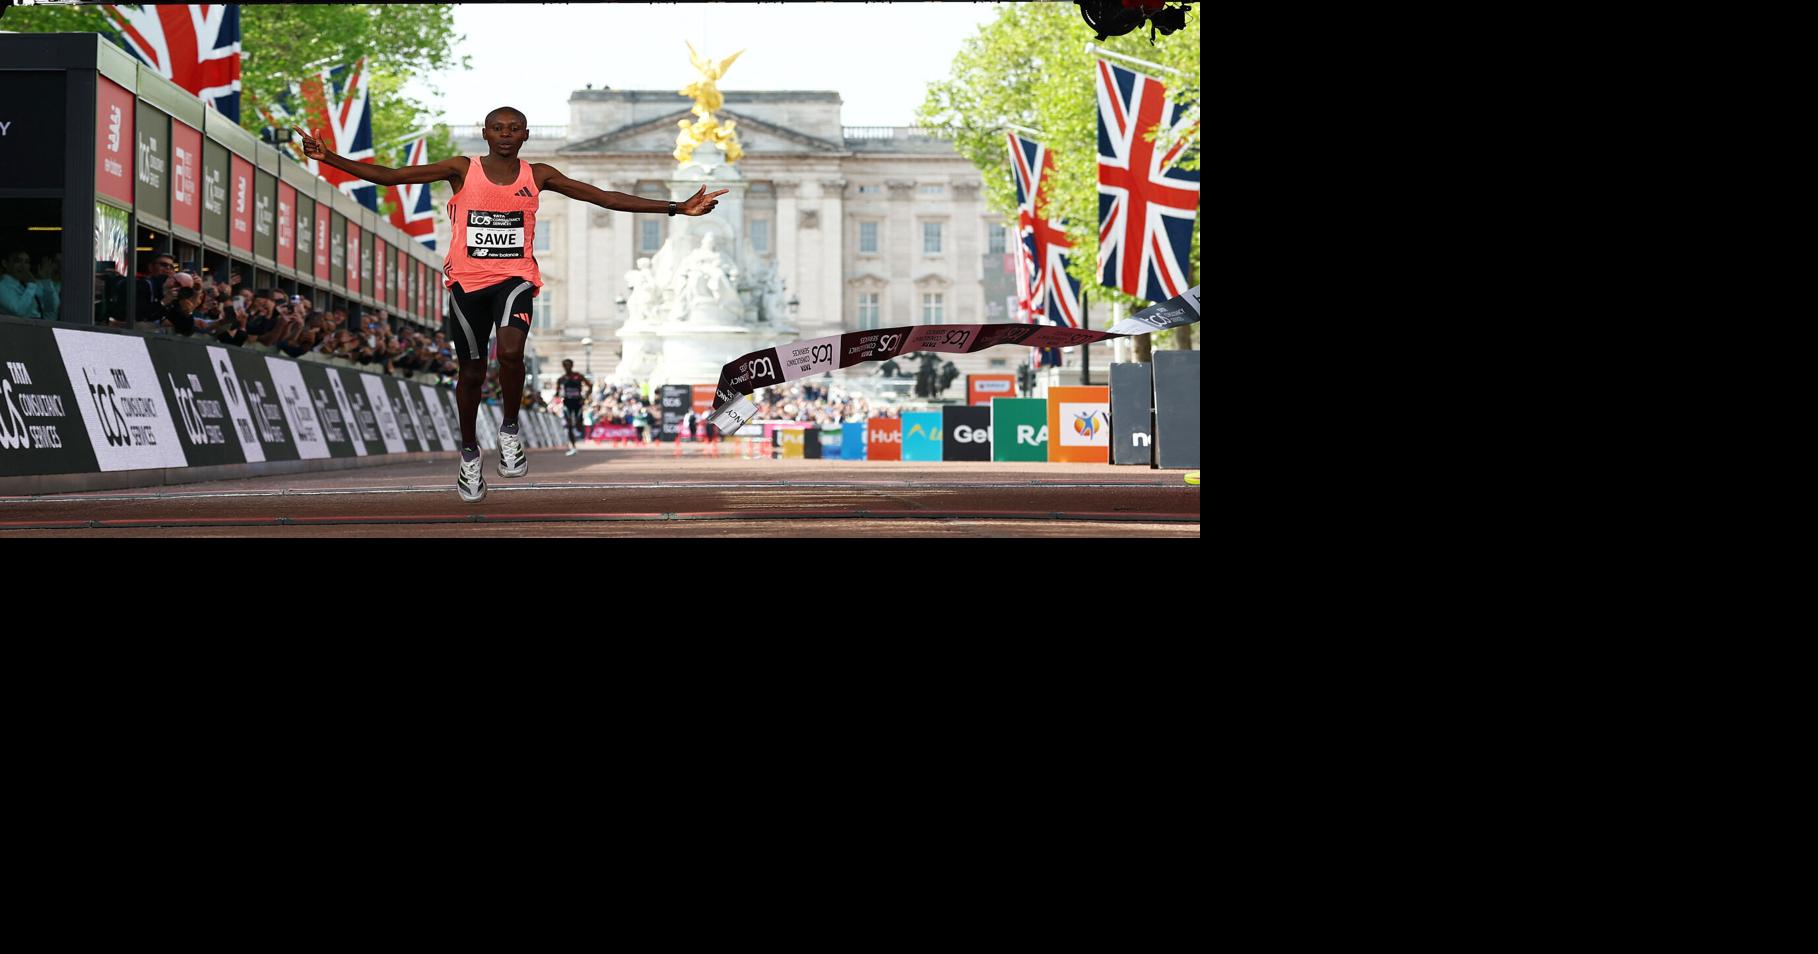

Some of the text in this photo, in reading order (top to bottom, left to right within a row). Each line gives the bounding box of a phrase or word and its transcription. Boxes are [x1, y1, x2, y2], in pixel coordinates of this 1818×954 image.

[471, 213, 491, 225] tcs
[475, 233, 516, 245] SAWE
[878, 334, 902, 353] tcs
[942, 330, 970, 349] tcs
[786, 355, 810, 368] CONSULTANCY
[792, 347, 810, 356] SERVICES
[811, 343, 833, 365] tcs
[6, 361, 32, 385] TATA
[110, 368, 131, 389] TATA
[748, 356, 775, 380] tcs
[800, 364, 811, 372] TATA
[18, 393, 66, 417] CONSULTANCY
[82, 367, 131, 447] tcs
[168, 372, 208, 445] tcs
[29, 425, 62, 449] SERVICES
[1017, 424, 1048, 446] RA
